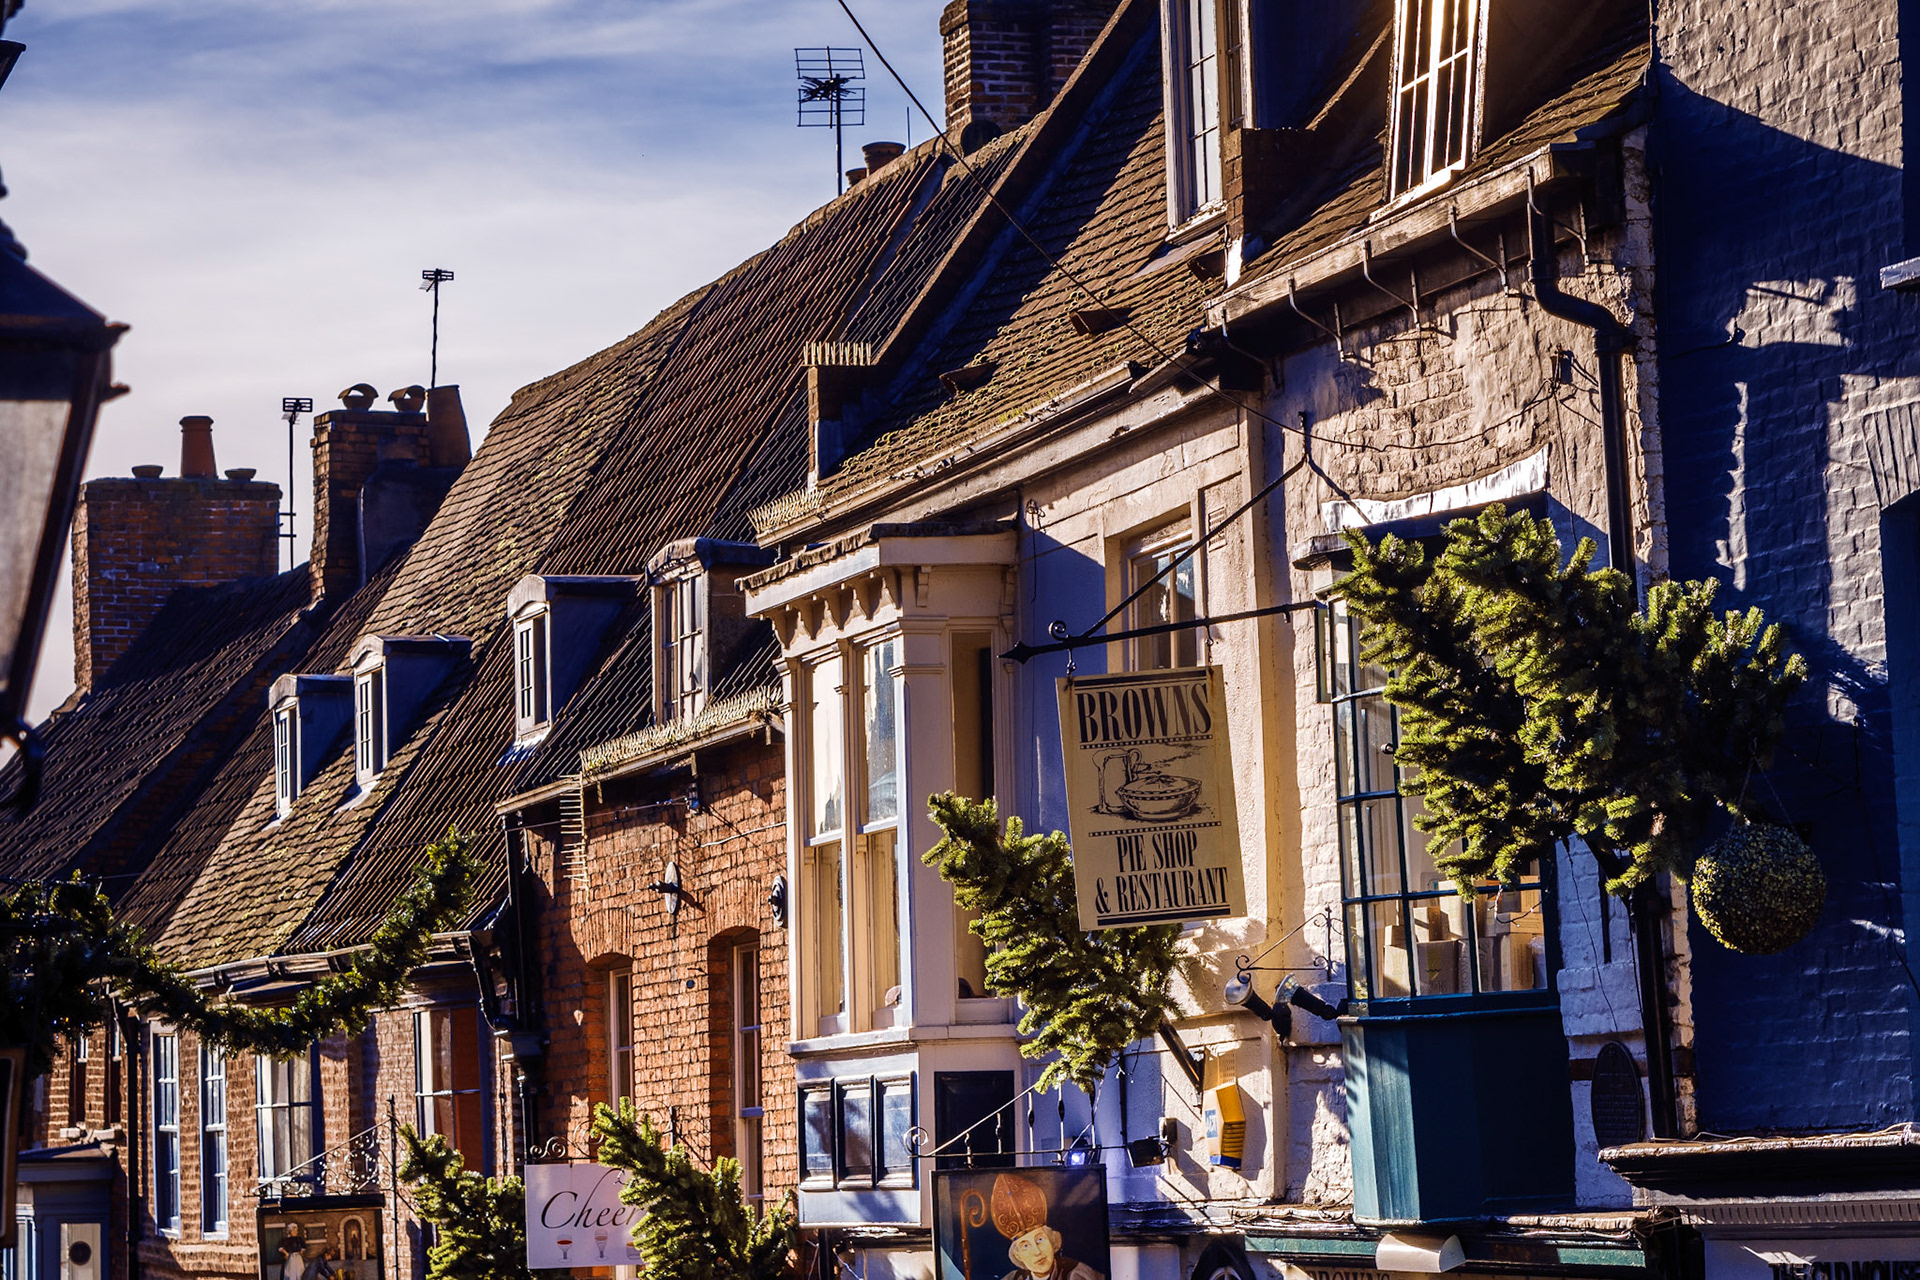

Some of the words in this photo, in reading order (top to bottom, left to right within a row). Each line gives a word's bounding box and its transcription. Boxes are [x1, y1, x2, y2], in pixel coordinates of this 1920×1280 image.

[1075, 683, 1211, 743] BROWNS
[1116, 835, 1147, 873] PIE
[1152, 830, 1197, 870] SHOP
[1095, 877, 1111, 914] &
[1115, 867, 1228, 912] RESTAURANT
[541, 1168, 647, 1229] Cheer
